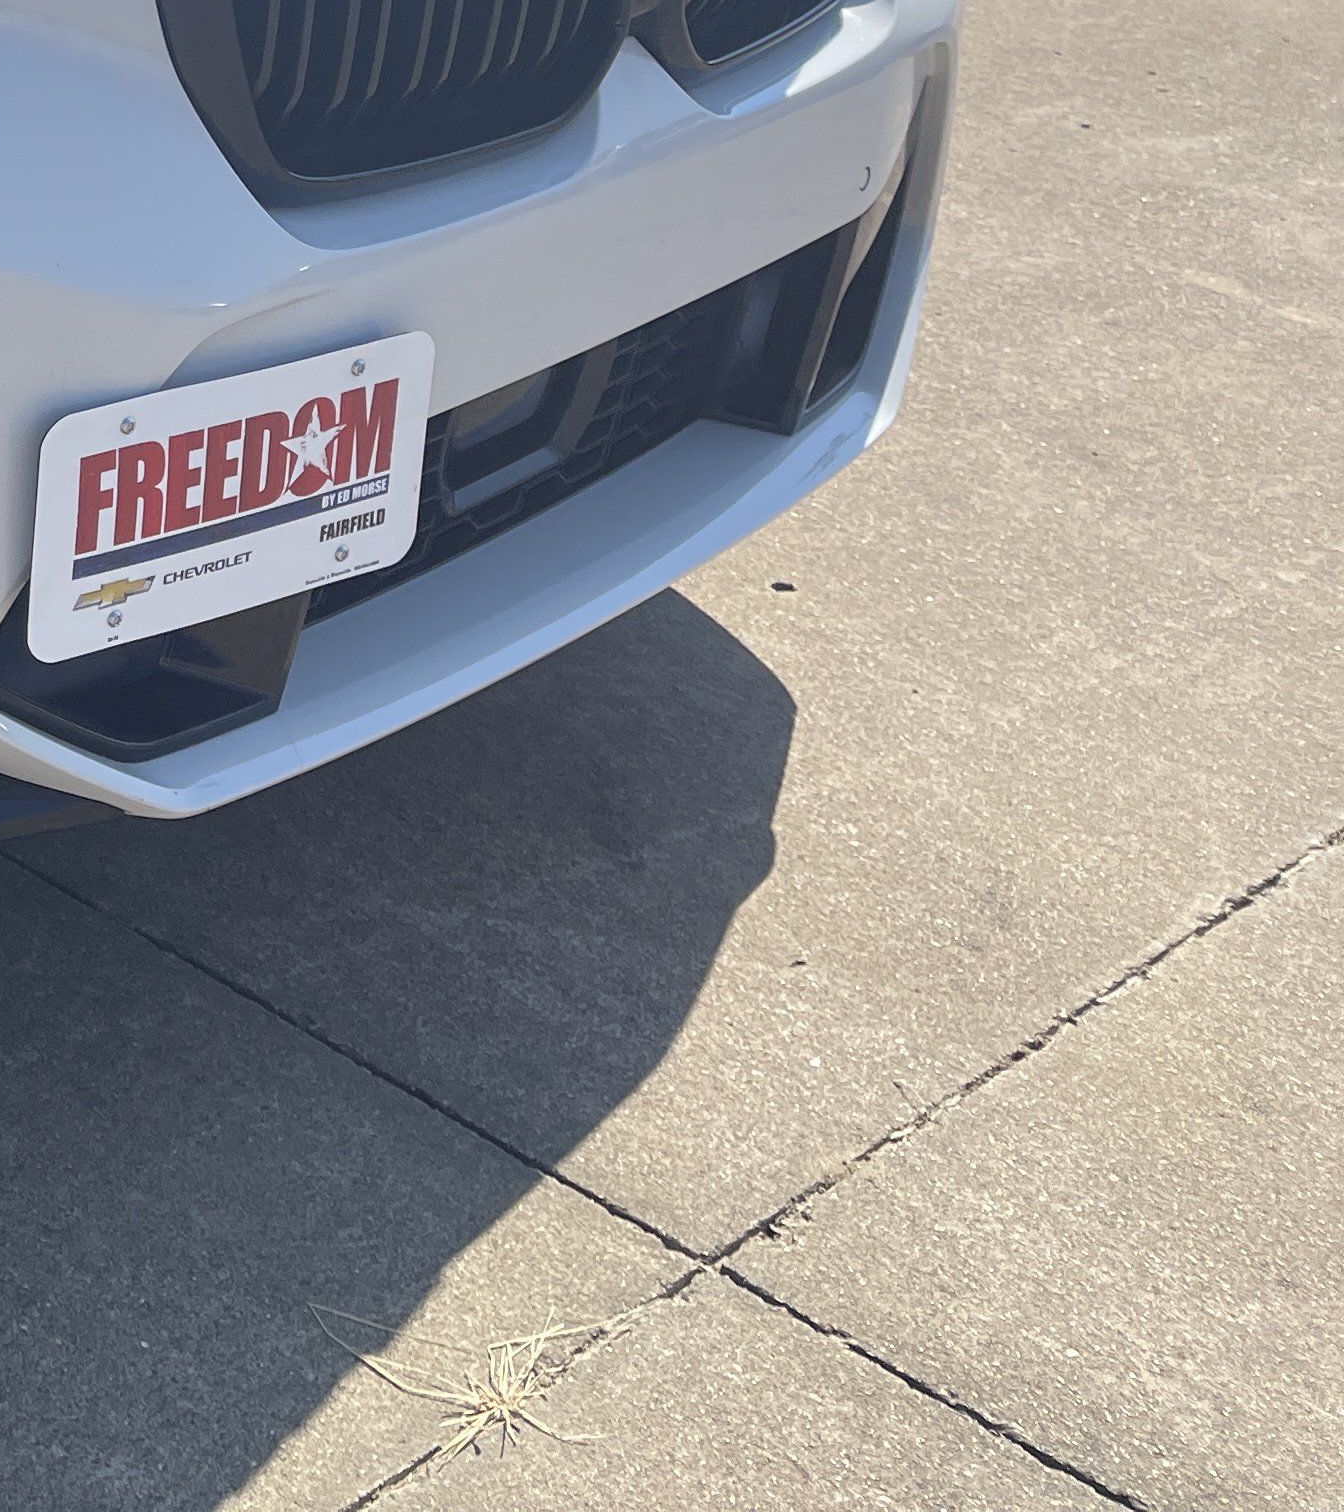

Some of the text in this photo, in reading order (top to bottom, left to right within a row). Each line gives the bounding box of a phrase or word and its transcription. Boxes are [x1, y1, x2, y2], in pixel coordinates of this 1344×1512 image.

[75, 377, 400, 556] FREEDOM
[321, 478, 388, 509] BY ED MORSE
[319, 508, 386, 542] FAIRFIELD
[163, 550, 253, 585] CHEVROLET
